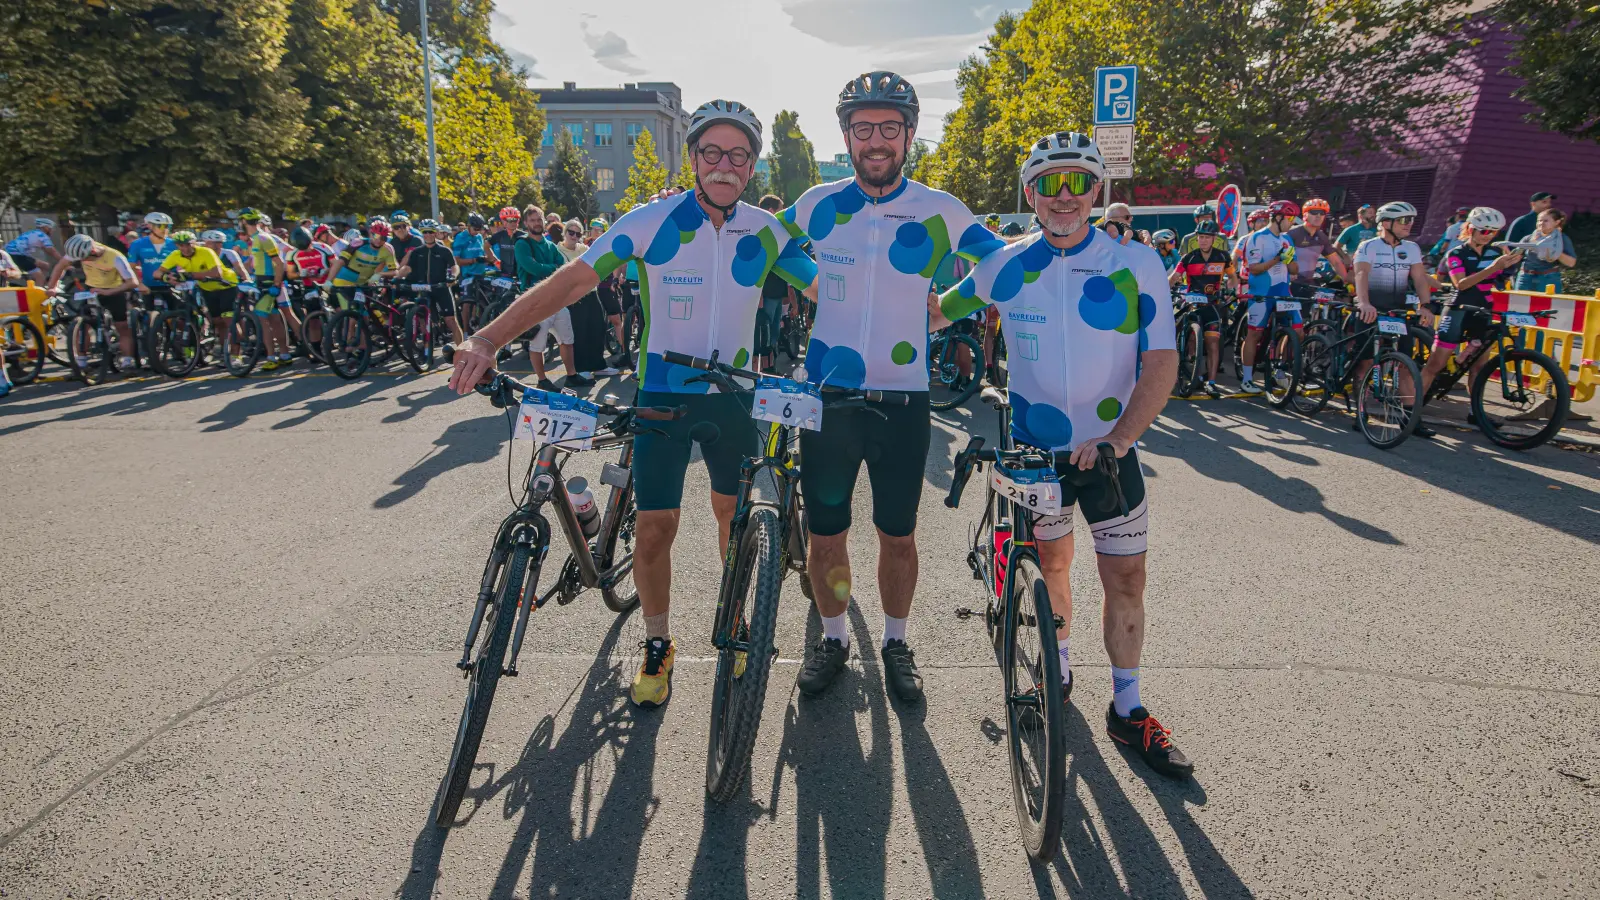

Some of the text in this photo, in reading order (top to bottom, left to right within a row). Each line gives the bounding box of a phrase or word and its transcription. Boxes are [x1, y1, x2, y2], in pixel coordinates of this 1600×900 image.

[1104, 74, 1127, 106] P
[821, 251, 855, 263] BAYREUTH
[663, 275, 703, 284] BAYREUTH
[1008, 311, 1046, 321] BAYREUTH
[782, 402, 792, 418] 6
[537, 417, 573, 439] 217
[1008, 486, 1038, 507] 218
